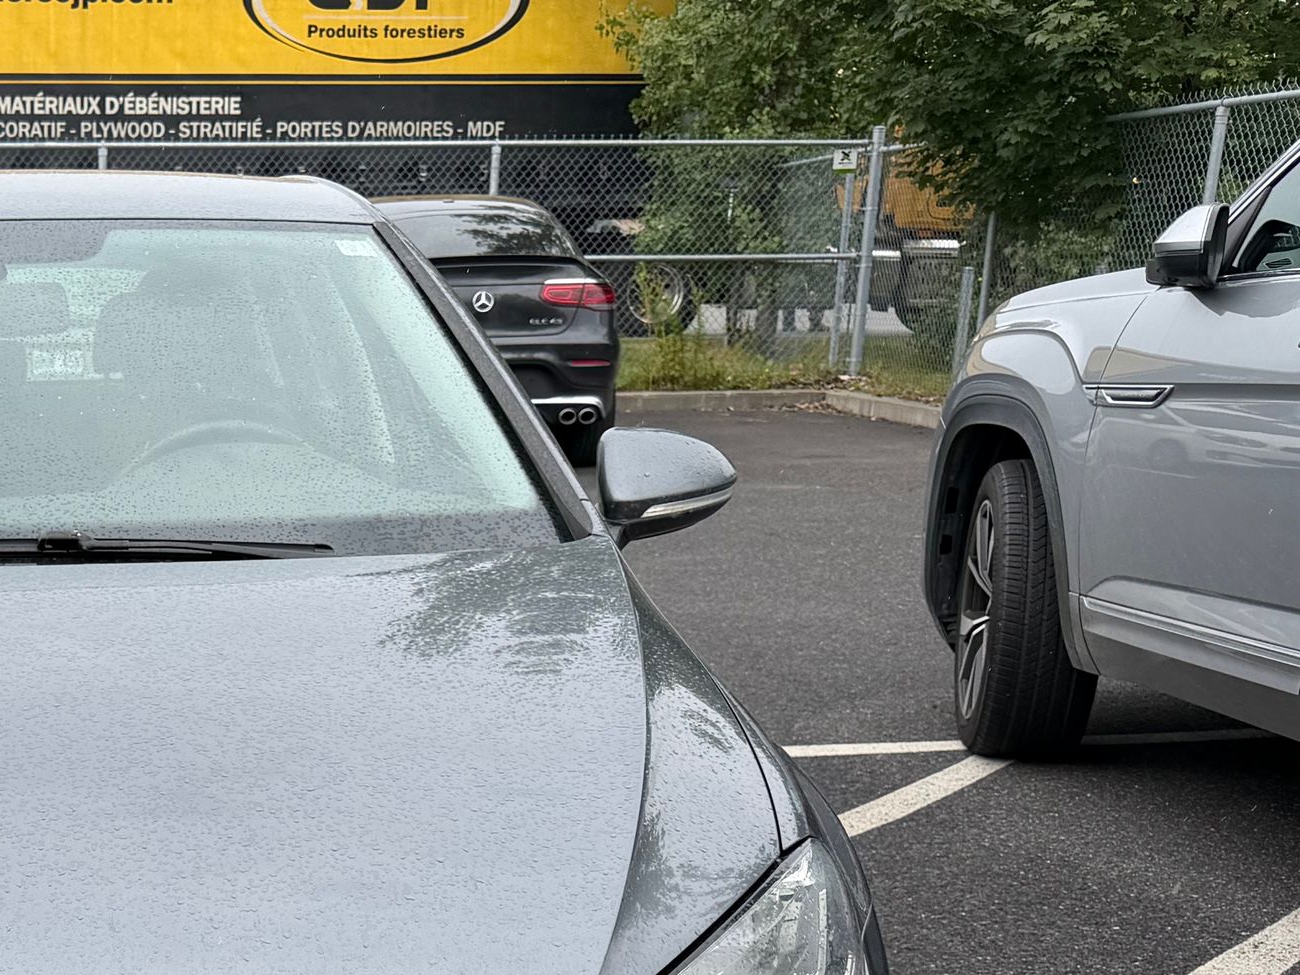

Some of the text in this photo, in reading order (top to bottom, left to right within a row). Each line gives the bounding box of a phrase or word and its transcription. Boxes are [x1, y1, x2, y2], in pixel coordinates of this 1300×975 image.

[307, 24, 465, 39] Produits forestiers
[105, 92, 242, 116] D'ÉBÉNISTERIE
[80, 121, 166, 138] PLYWOOD
[178, 117, 263, 138] STRATIFIÉ
[276, 121, 343, 138] PORTES
[347, 120, 454, 138] D'ARMOIRES
[467, 121, 505, 137] MDF
